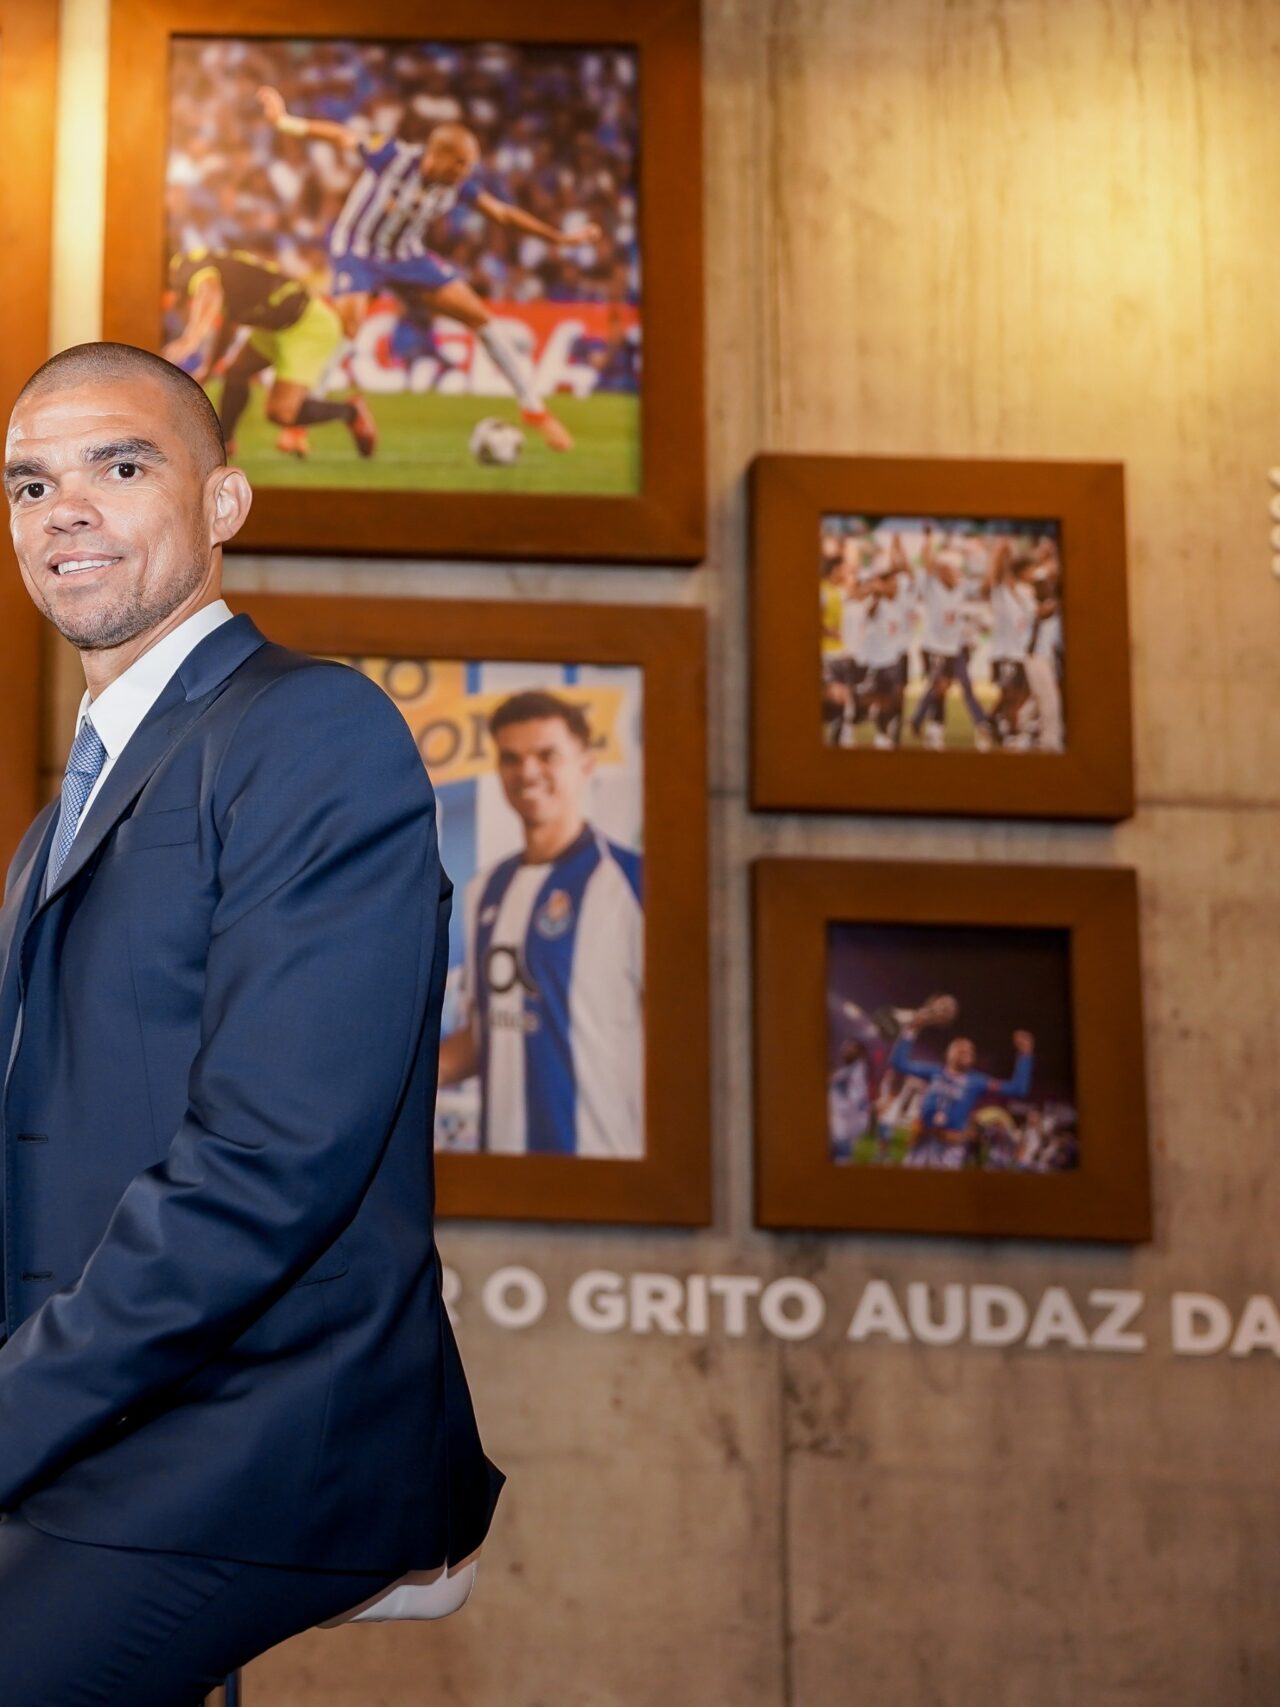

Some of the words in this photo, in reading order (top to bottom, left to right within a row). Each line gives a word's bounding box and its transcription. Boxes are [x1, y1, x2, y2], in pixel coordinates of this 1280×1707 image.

[481, 1265, 548, 1330] O
[568, 1269, 827, 1341] GRITO
[846, 1279, 1146, 1354] AUDAZ
[1170, 1291, 1280, 1359] DA
